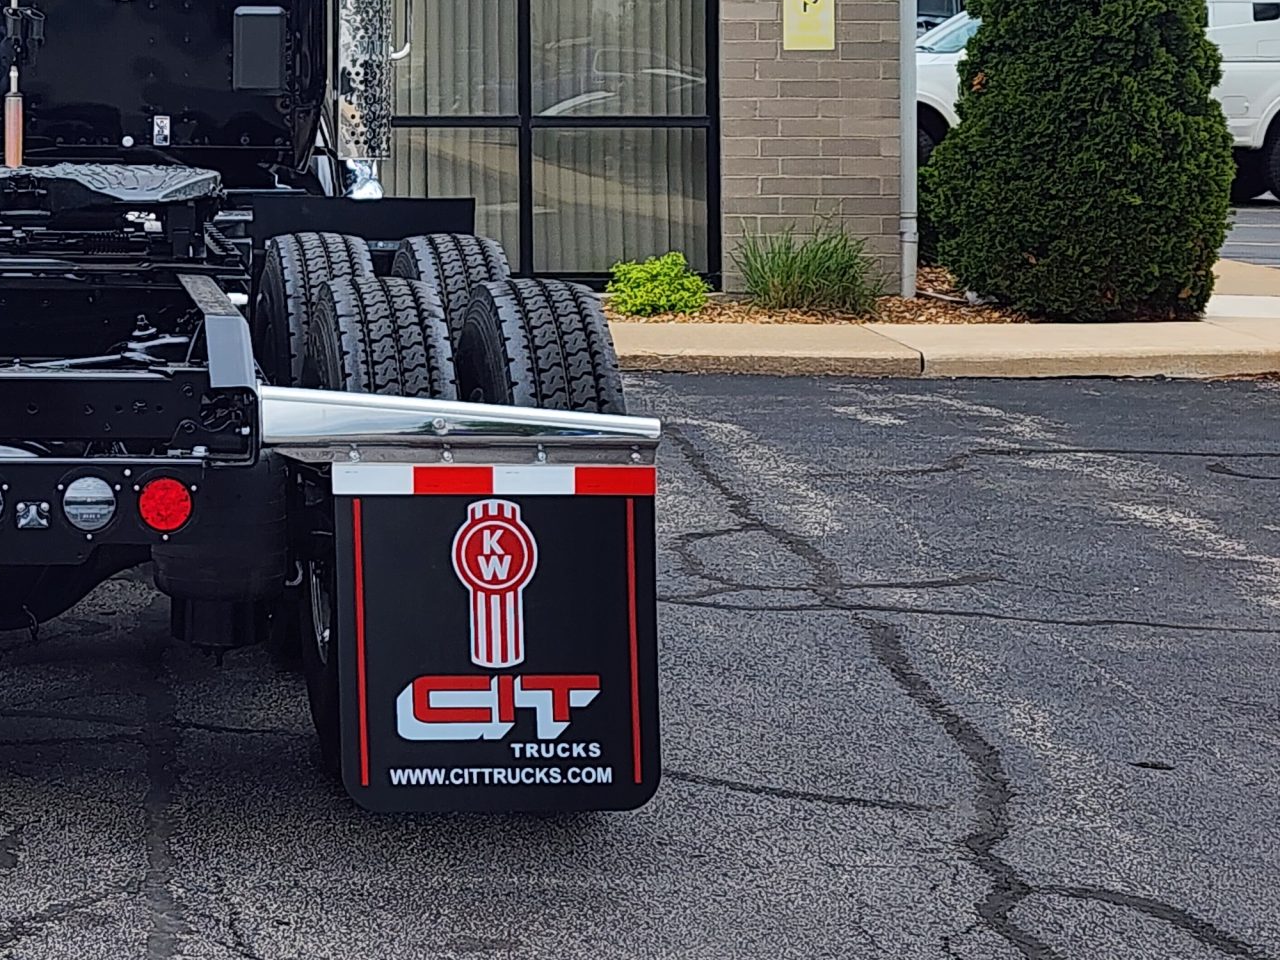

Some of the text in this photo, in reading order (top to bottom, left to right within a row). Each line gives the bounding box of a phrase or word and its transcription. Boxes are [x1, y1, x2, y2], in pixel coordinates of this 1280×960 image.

[396, 674, 601, 741] CIT
[510, 742, 601, 758] TRUCKS
[389, 766, 613, 786] WWW.CITTRUCKS.COM
